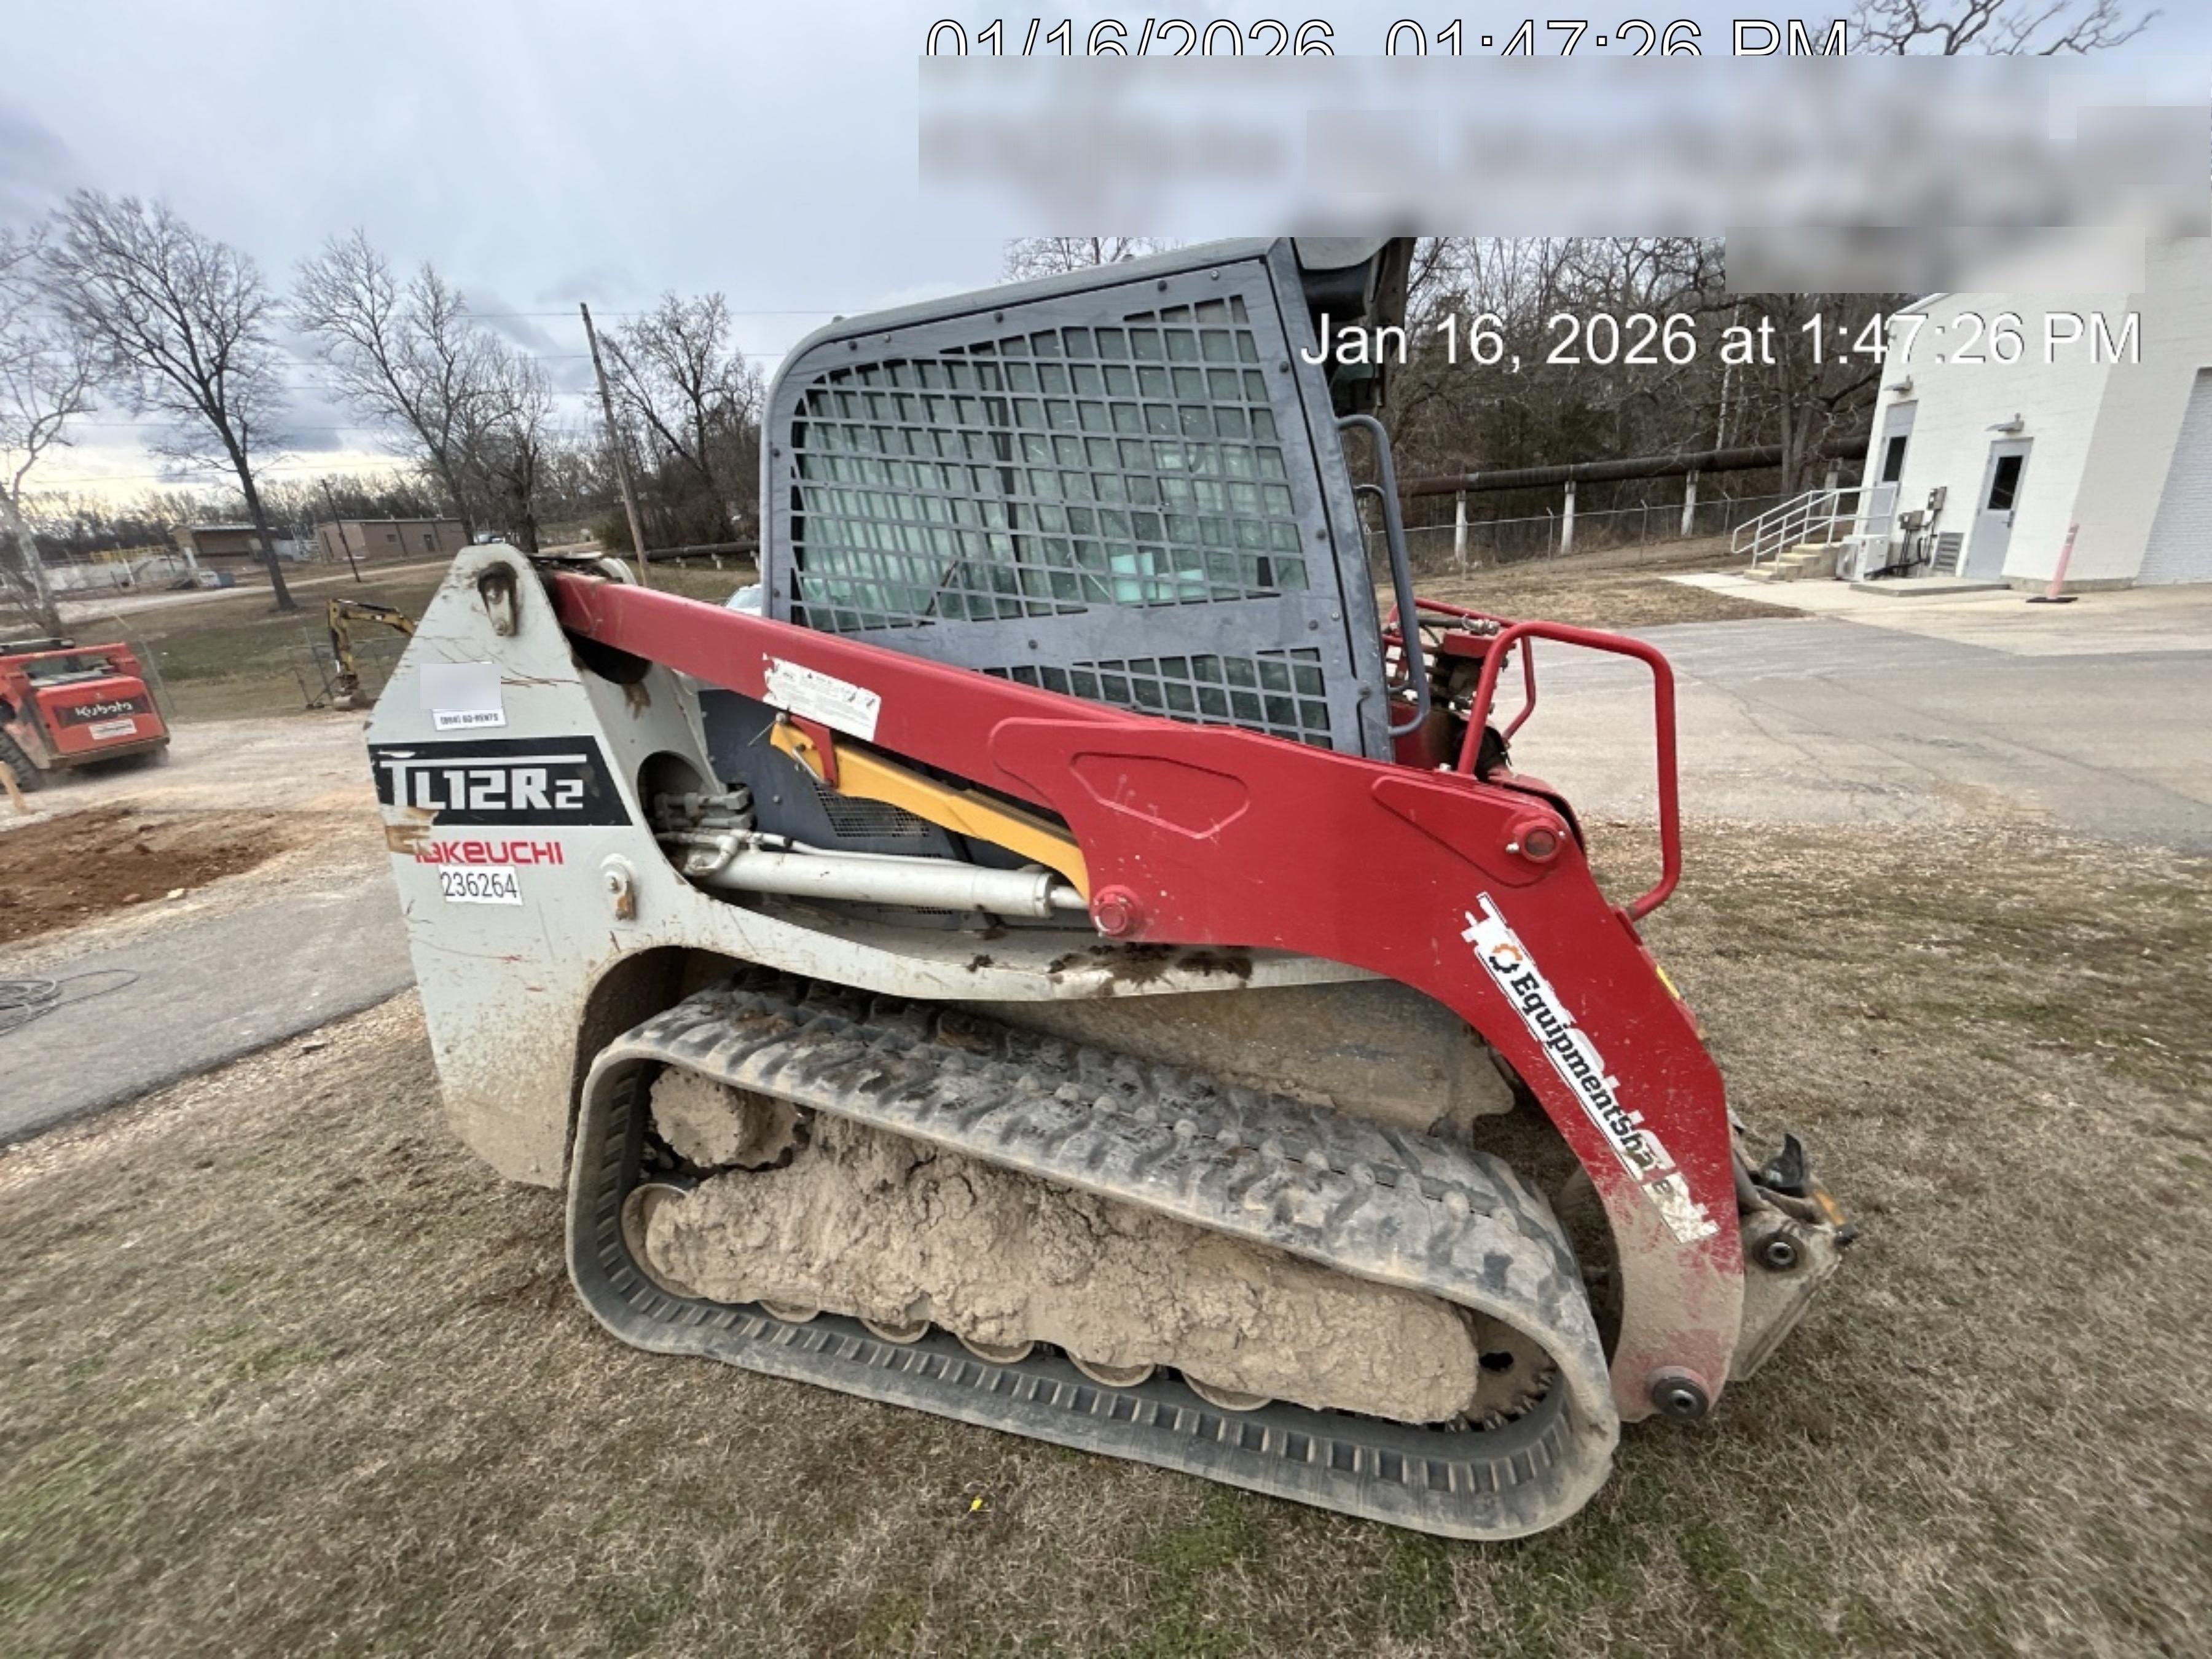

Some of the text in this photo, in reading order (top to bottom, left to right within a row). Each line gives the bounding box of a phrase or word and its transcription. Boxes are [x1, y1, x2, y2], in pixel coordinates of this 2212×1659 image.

[75, 700, 133, 718] Kubota
[440, 871, 518, 898] 236264
[1510, 971, 1676, 1195] EquipmentShae
